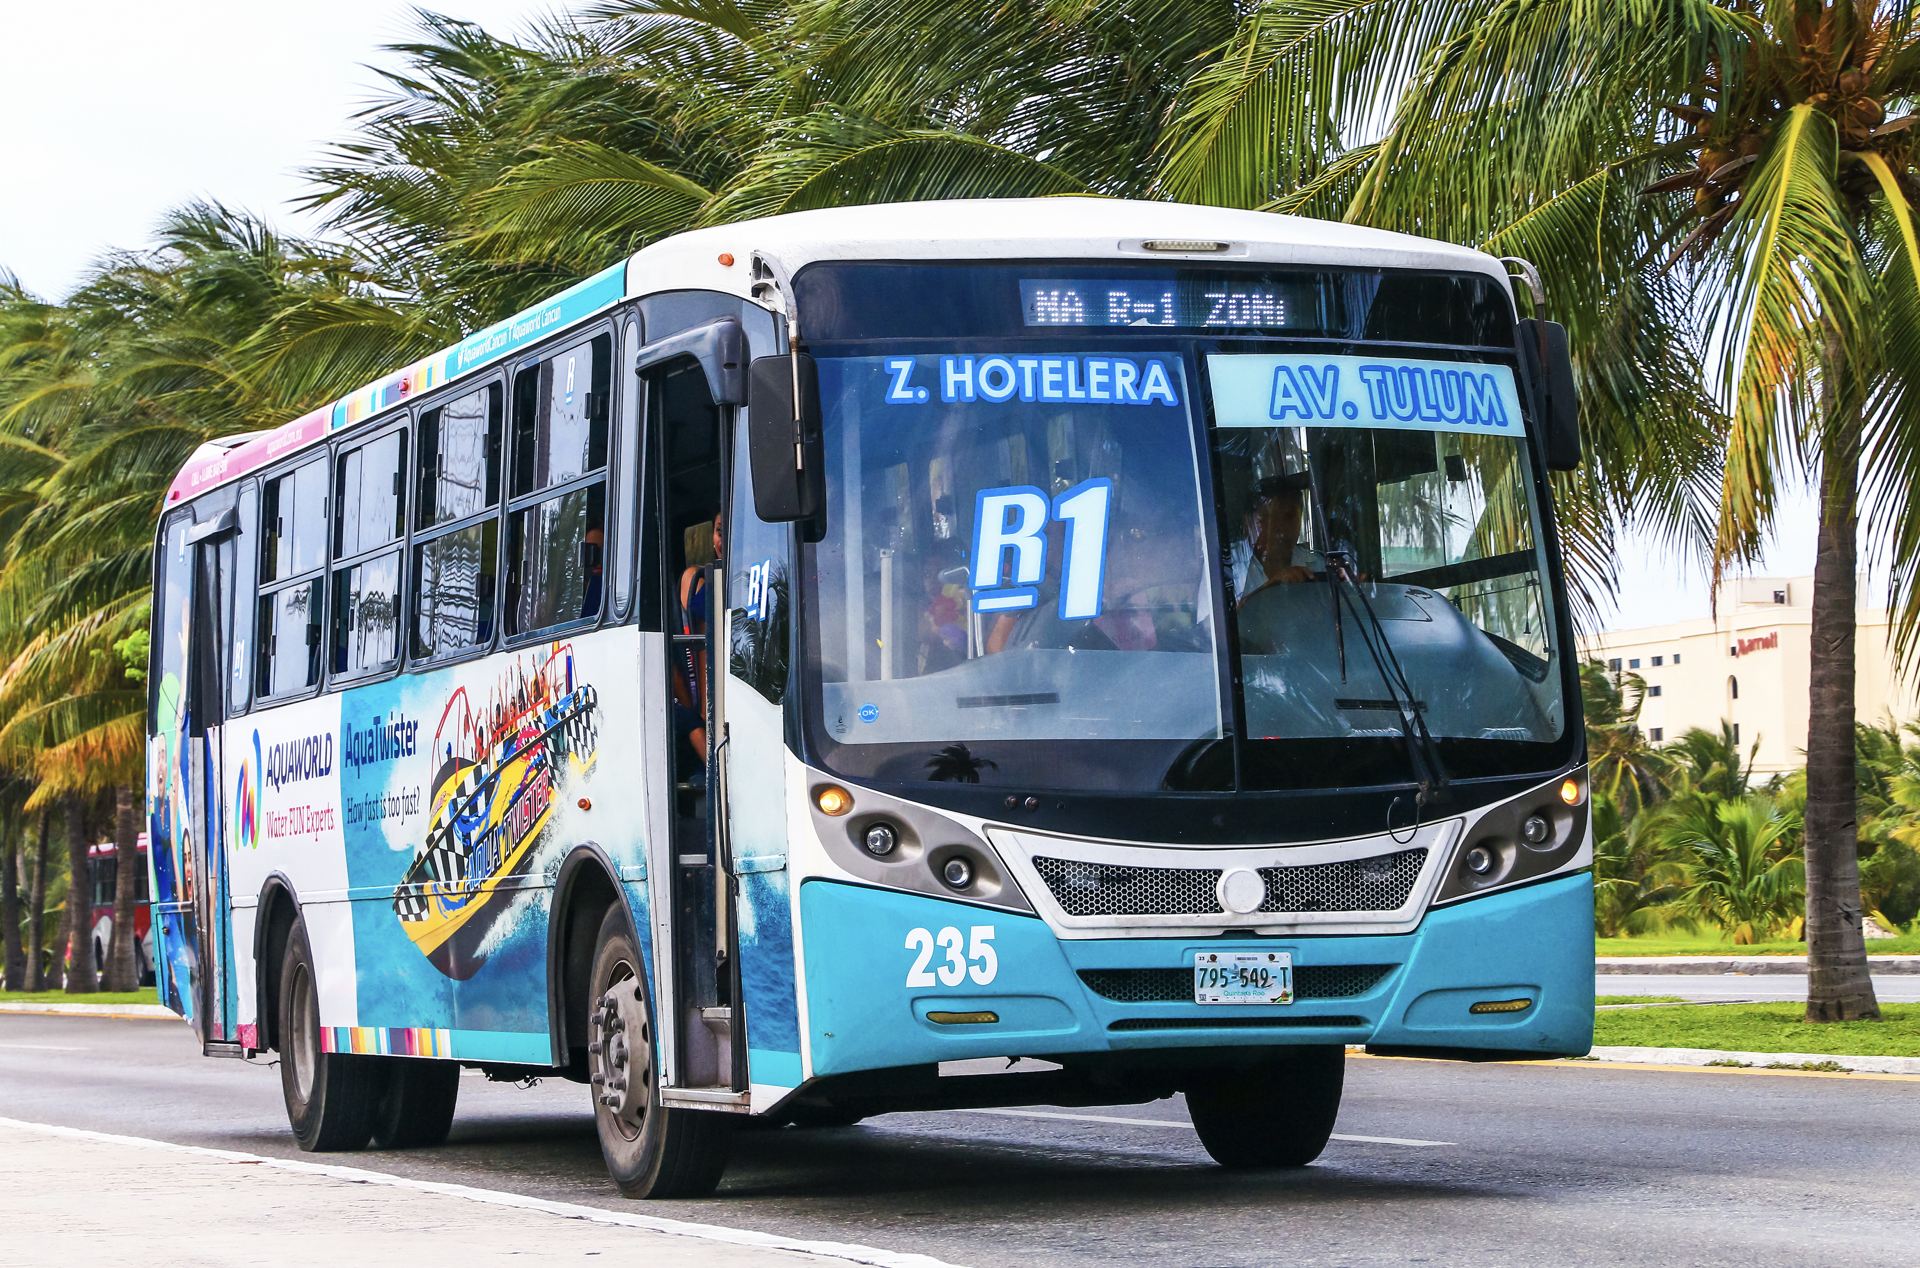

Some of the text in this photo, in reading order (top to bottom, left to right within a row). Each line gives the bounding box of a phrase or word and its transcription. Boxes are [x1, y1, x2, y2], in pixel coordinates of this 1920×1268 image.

[1036, 291, 1082, 322] NA
[1109, 292, 1175, 323] R-1
[886, 356, 1177, 404] Z. HOTELERA
[1269, 364, 1509, 427] AV. TULUM
[970, 478, 1111, 620] R1
[747, 560, 770, 620] R1
[862, 709, 875, 717] OK
[266, 732, 333, 793] AQUAWORLD
[345, 712, 419, 779] AquaTwister
[266, 802, 335, 842] Water FUN Experts
[347, 785, 421, 831] How fast is too fast?
[465, 767, 550, 892] AQUA TWISTER
[904, 925, 999, 988] 235
[1198, 966, 1289, 989] 795-549-T
